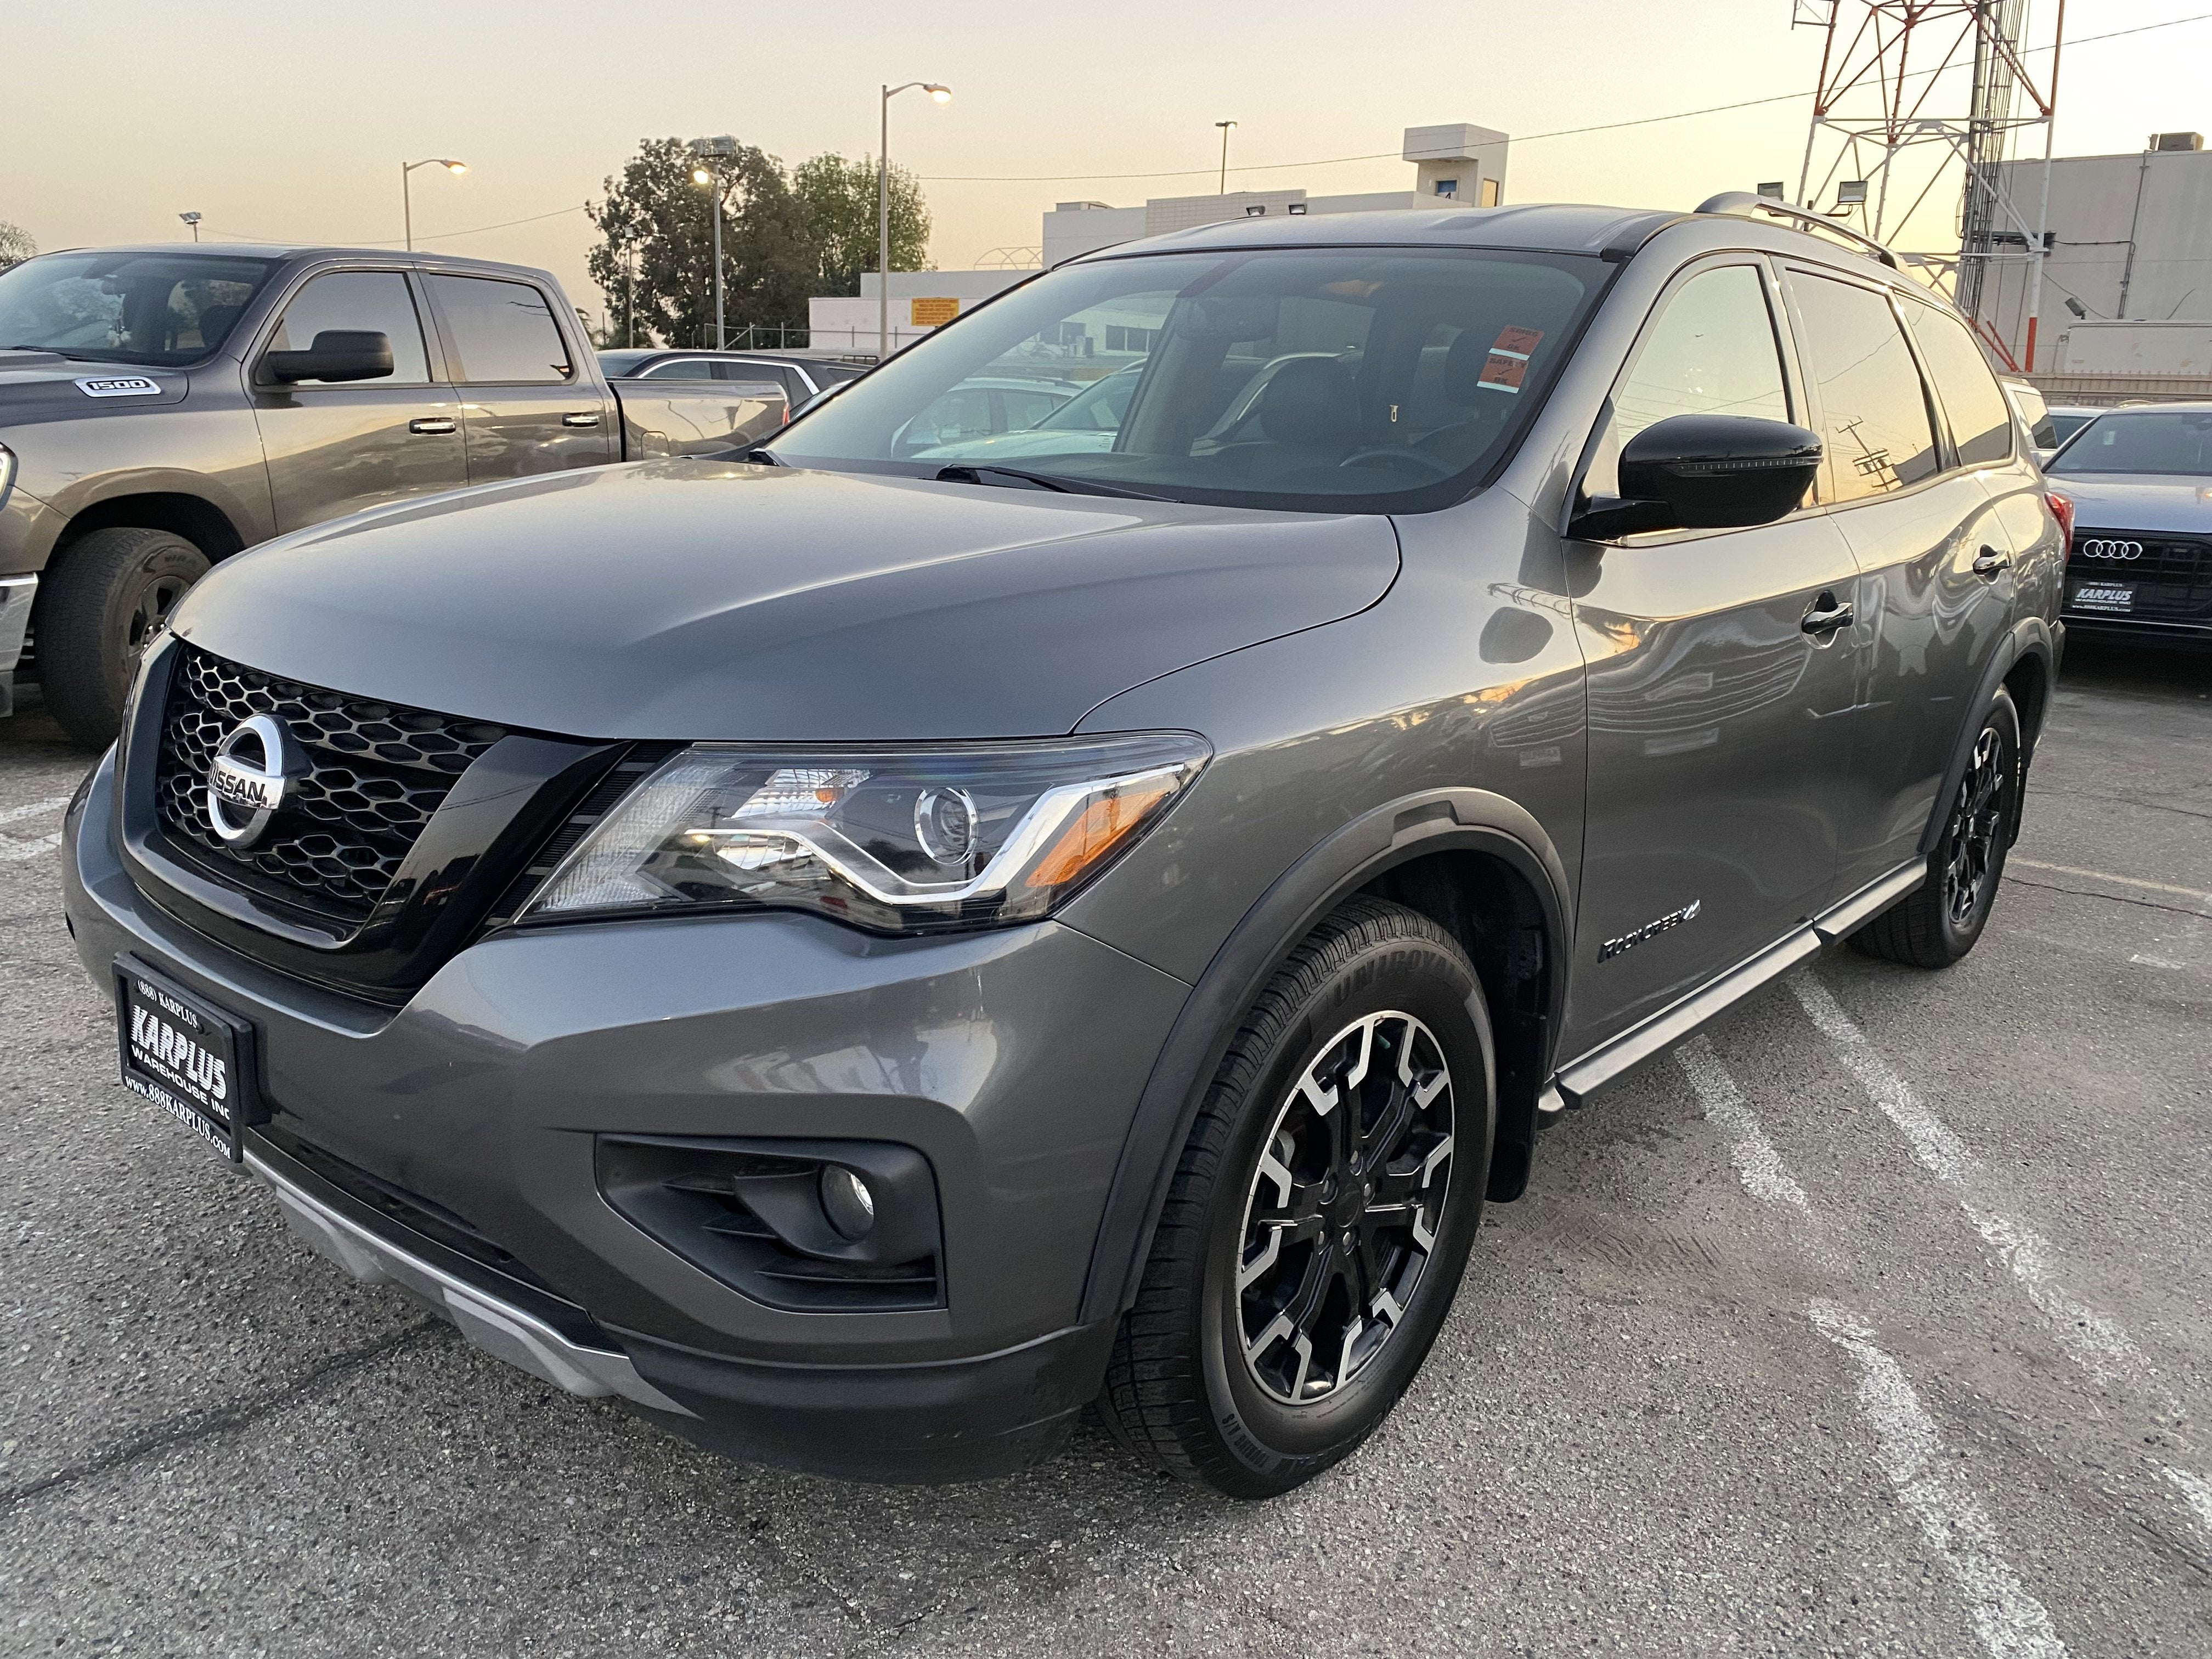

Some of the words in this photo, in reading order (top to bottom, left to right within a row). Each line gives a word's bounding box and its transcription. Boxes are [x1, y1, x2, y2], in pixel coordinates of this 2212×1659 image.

[1489, 358, 1527, 368] SAFETY
[89, 380, 146, 390] 1500
[2076, 588, 2133, 601] KARPLUS
[208, 760, 266, 802] NISSAN
[137, 979, 157, 1001] (888)
[159, 992, 198, 1028] KARPLUS
[131, 1005, 227, 1099] KARPLUS
[131, 1045, 208, 1105] WAREHOUSE
